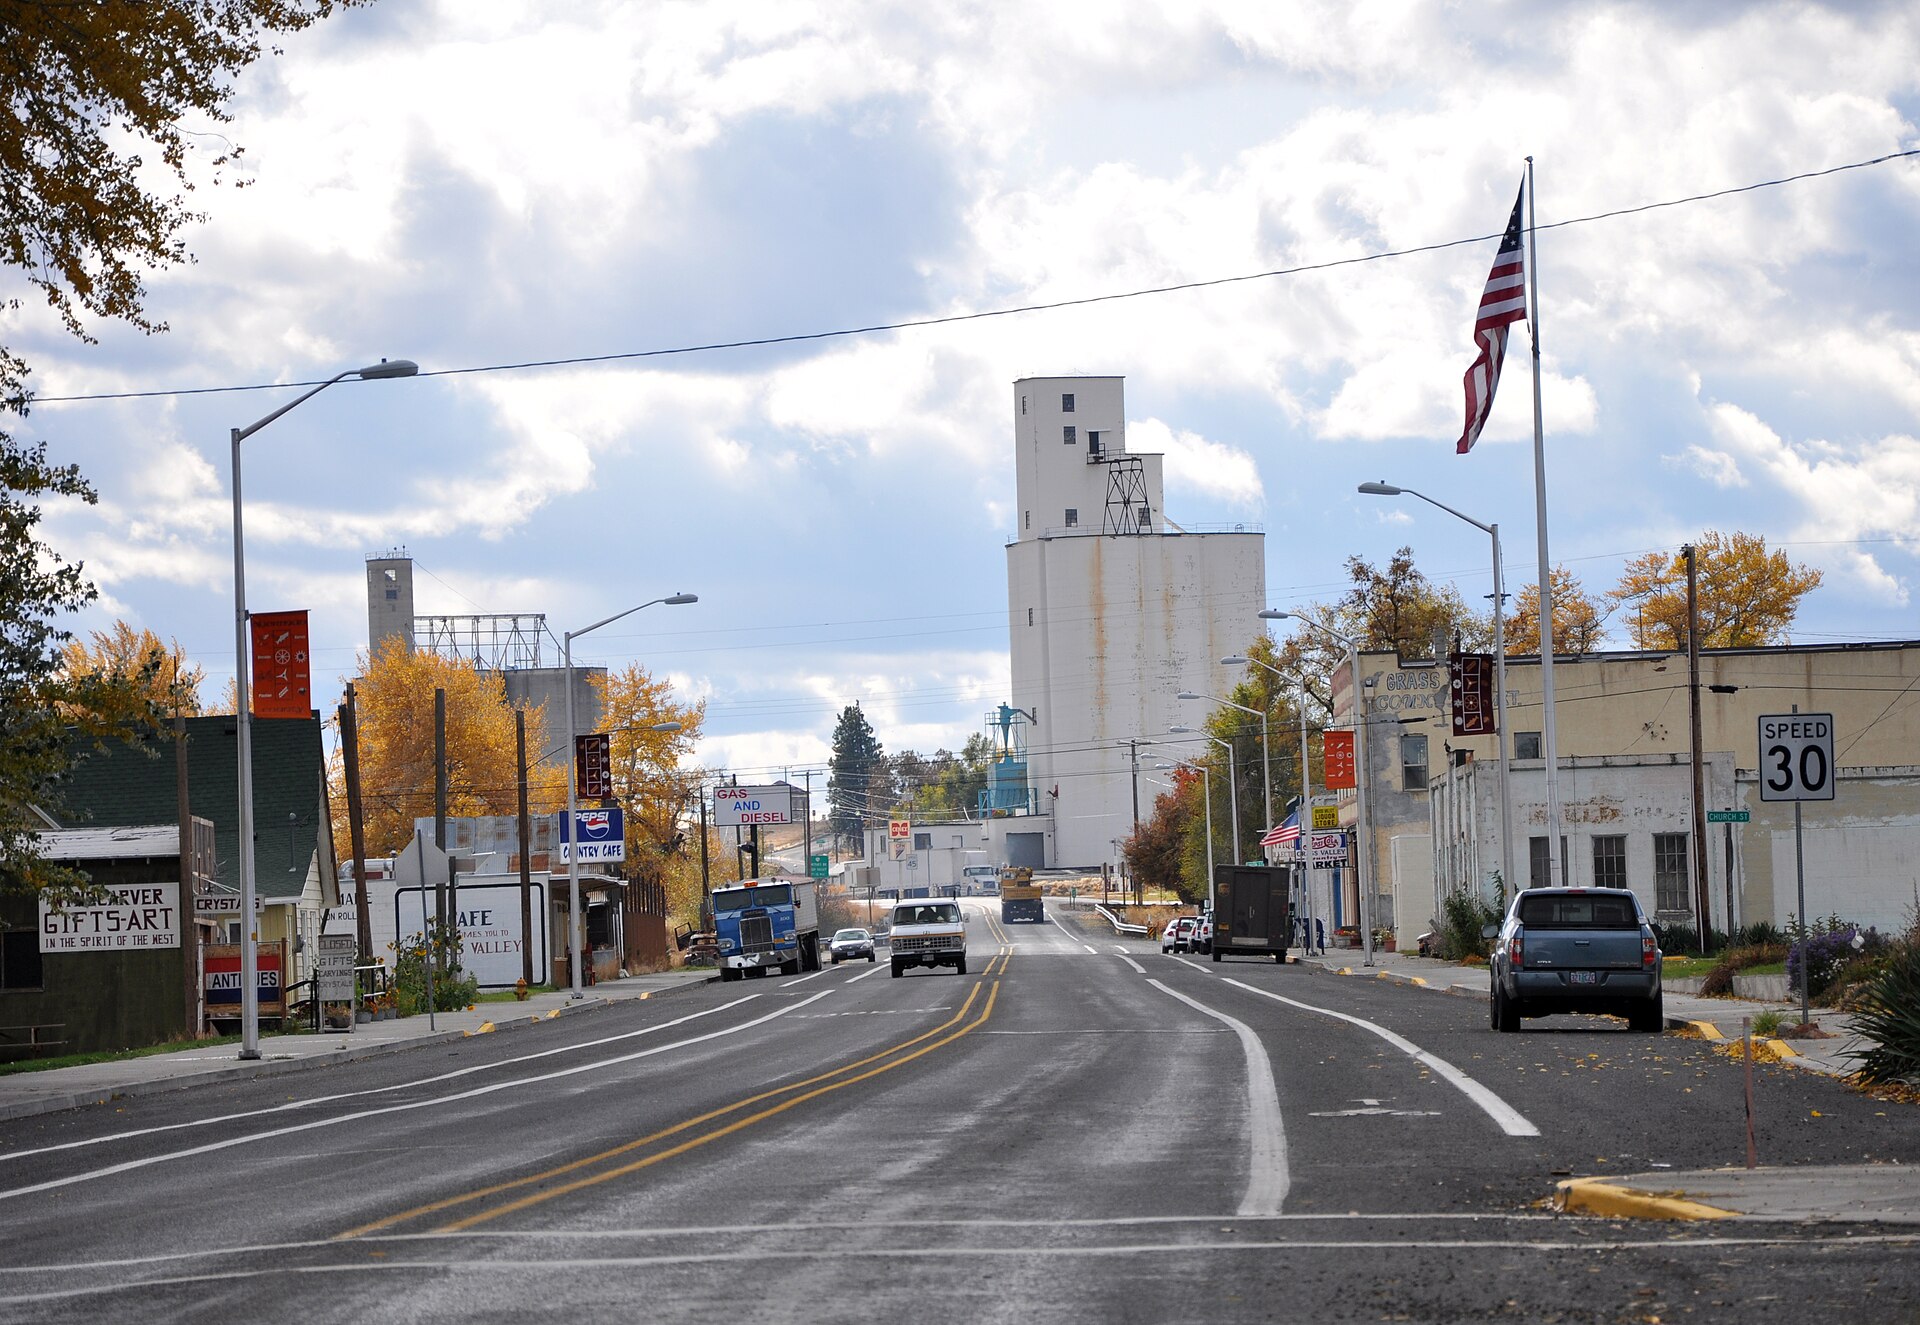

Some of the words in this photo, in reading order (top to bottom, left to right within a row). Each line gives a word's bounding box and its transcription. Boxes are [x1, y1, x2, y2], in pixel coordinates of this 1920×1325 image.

[1387, 671, 1441, 691] GRASS
[1765, 722, 1827, 739] SPEED
[1767, 745, 1827, 791] 30
[717, 789, 748, 799] GAS
[733, 801, 760, 811] AND
[575, 811, 609, 822] PEPSI
[741, 813, 788, 823] DIESEL
[1709, 813, 1737, 821] CHURCH
[1740, 812, 1748, 821] ST
[1315, 819, 1336, 827] STORE
[563, 846, 599, 858] CNTRY
[603, 844, 622, 857] CAFE
[1320, 849, 1346, 857] VALLEY
[196, 898, 260, 910] CRYSTAS
[44, 908, 173, 934] GIFTS-ART
[457, 909, 493, 927] AFE
[484, 930, 498, 938] YOU
[500, 929, 509, 937] TO
[45, 938, 56, 948] IN
[60, 937, 77, 947] THE
[80, 935, 113, 947] SPIRIT
[116, 935, 128, 945] OF
[132, 934, 149, 946] THE
[152, 933, 175, 945] WEST
[320, 940, 353, 949] CLOSED
[471, 940, 522, 954] VALLEY
[320, 956, 353, 966] GIFTS
[320, 969, 353, 977] CARVINGS
[212, 972, 278, 988] ANTIES
